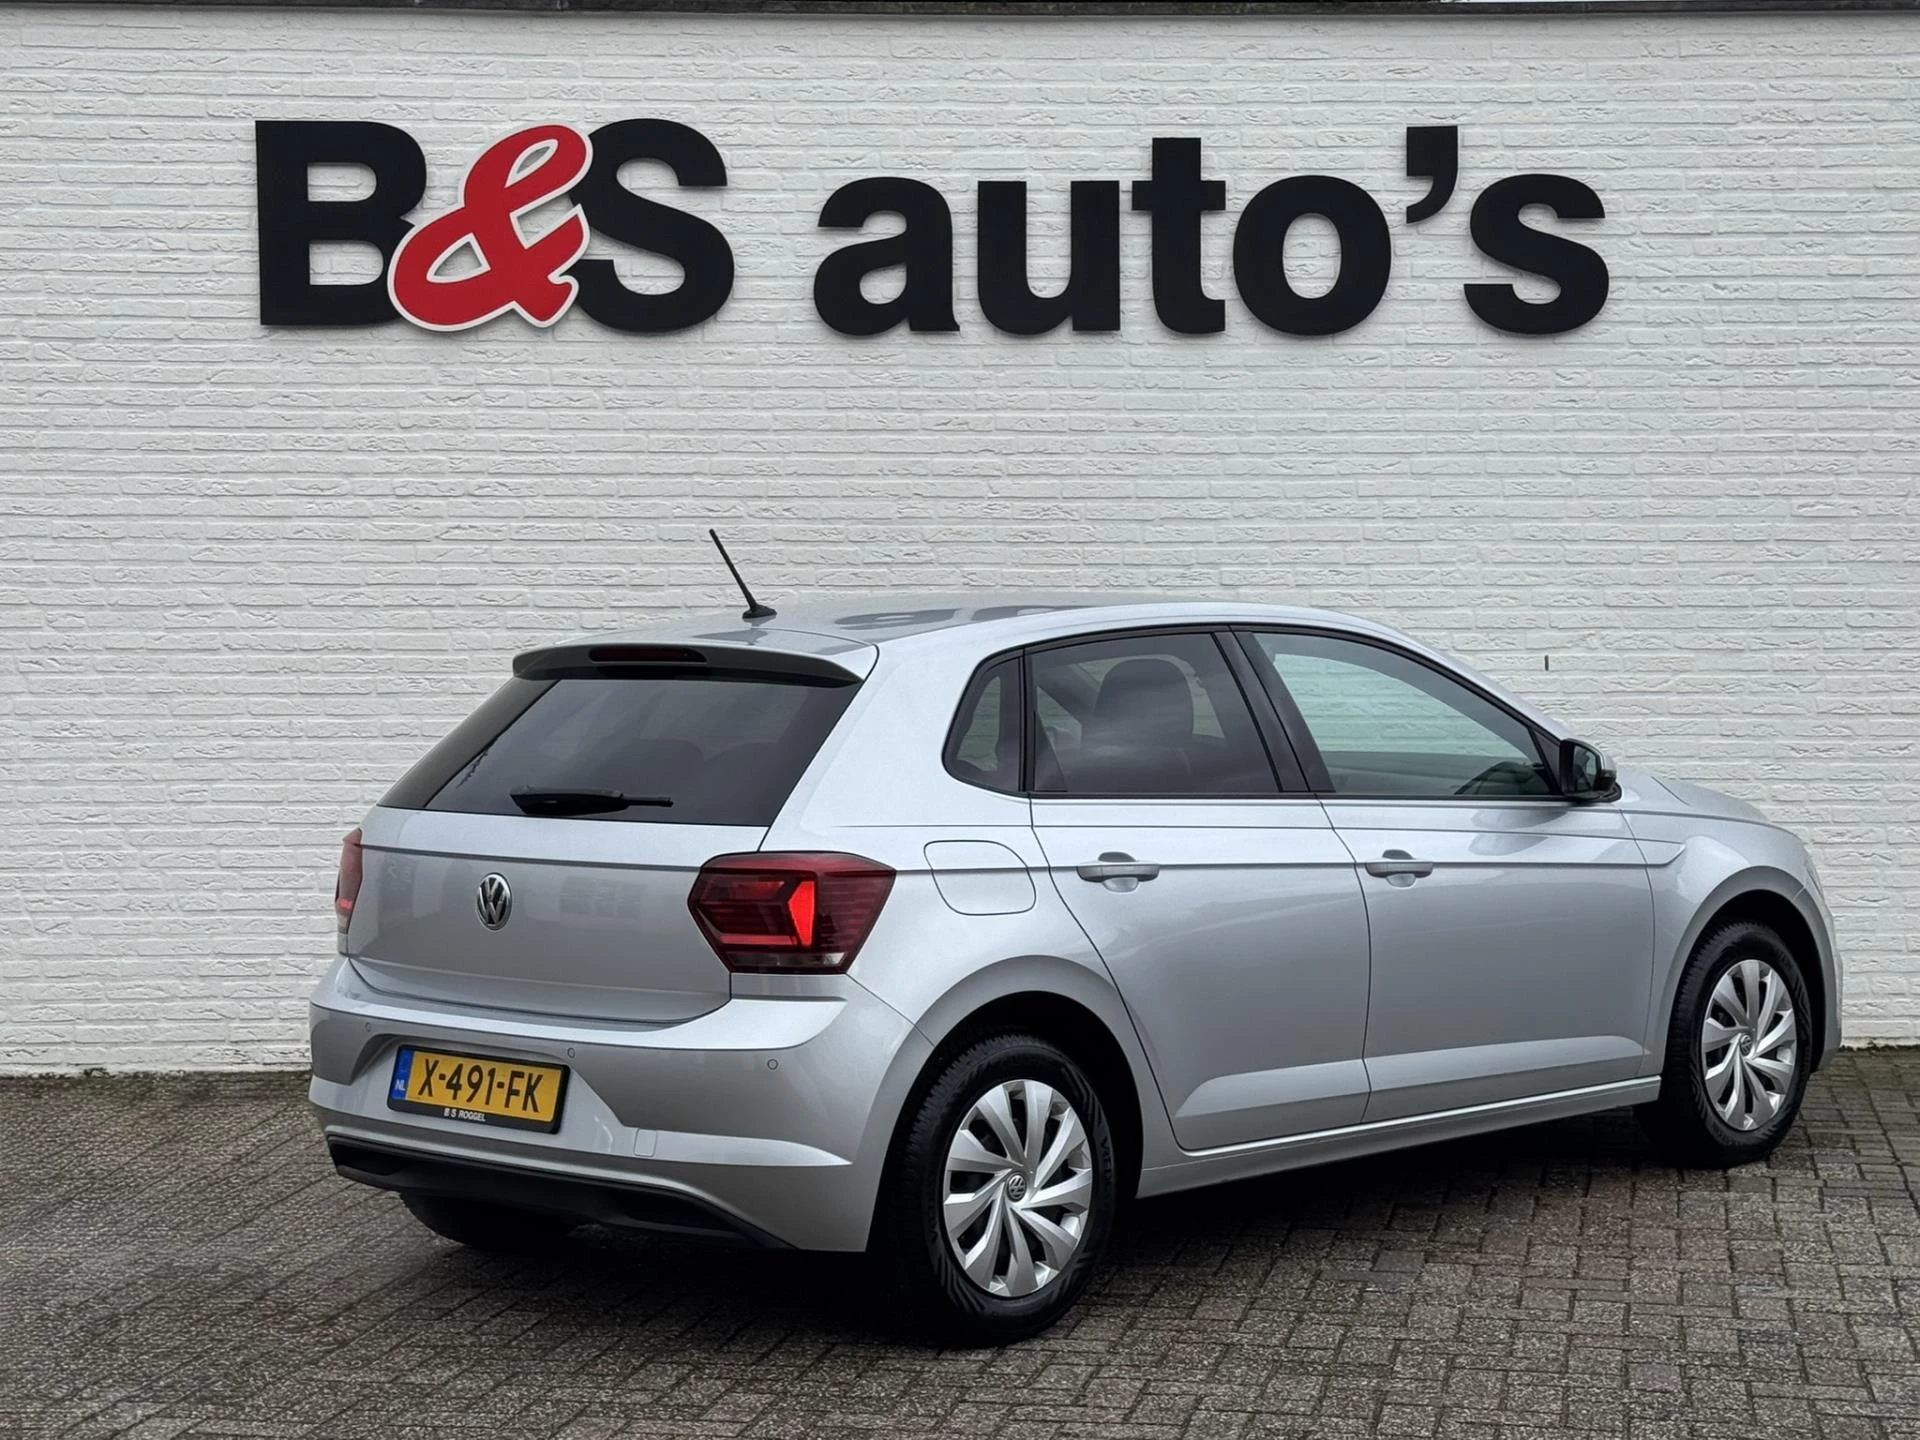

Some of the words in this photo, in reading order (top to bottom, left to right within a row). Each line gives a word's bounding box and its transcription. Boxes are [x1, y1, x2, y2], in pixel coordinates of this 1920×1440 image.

[255, 118, 735, 332] B&S
[395, 1079, 405, 1091] NL
[418, 1058, 543, 1113] X-491-FK
